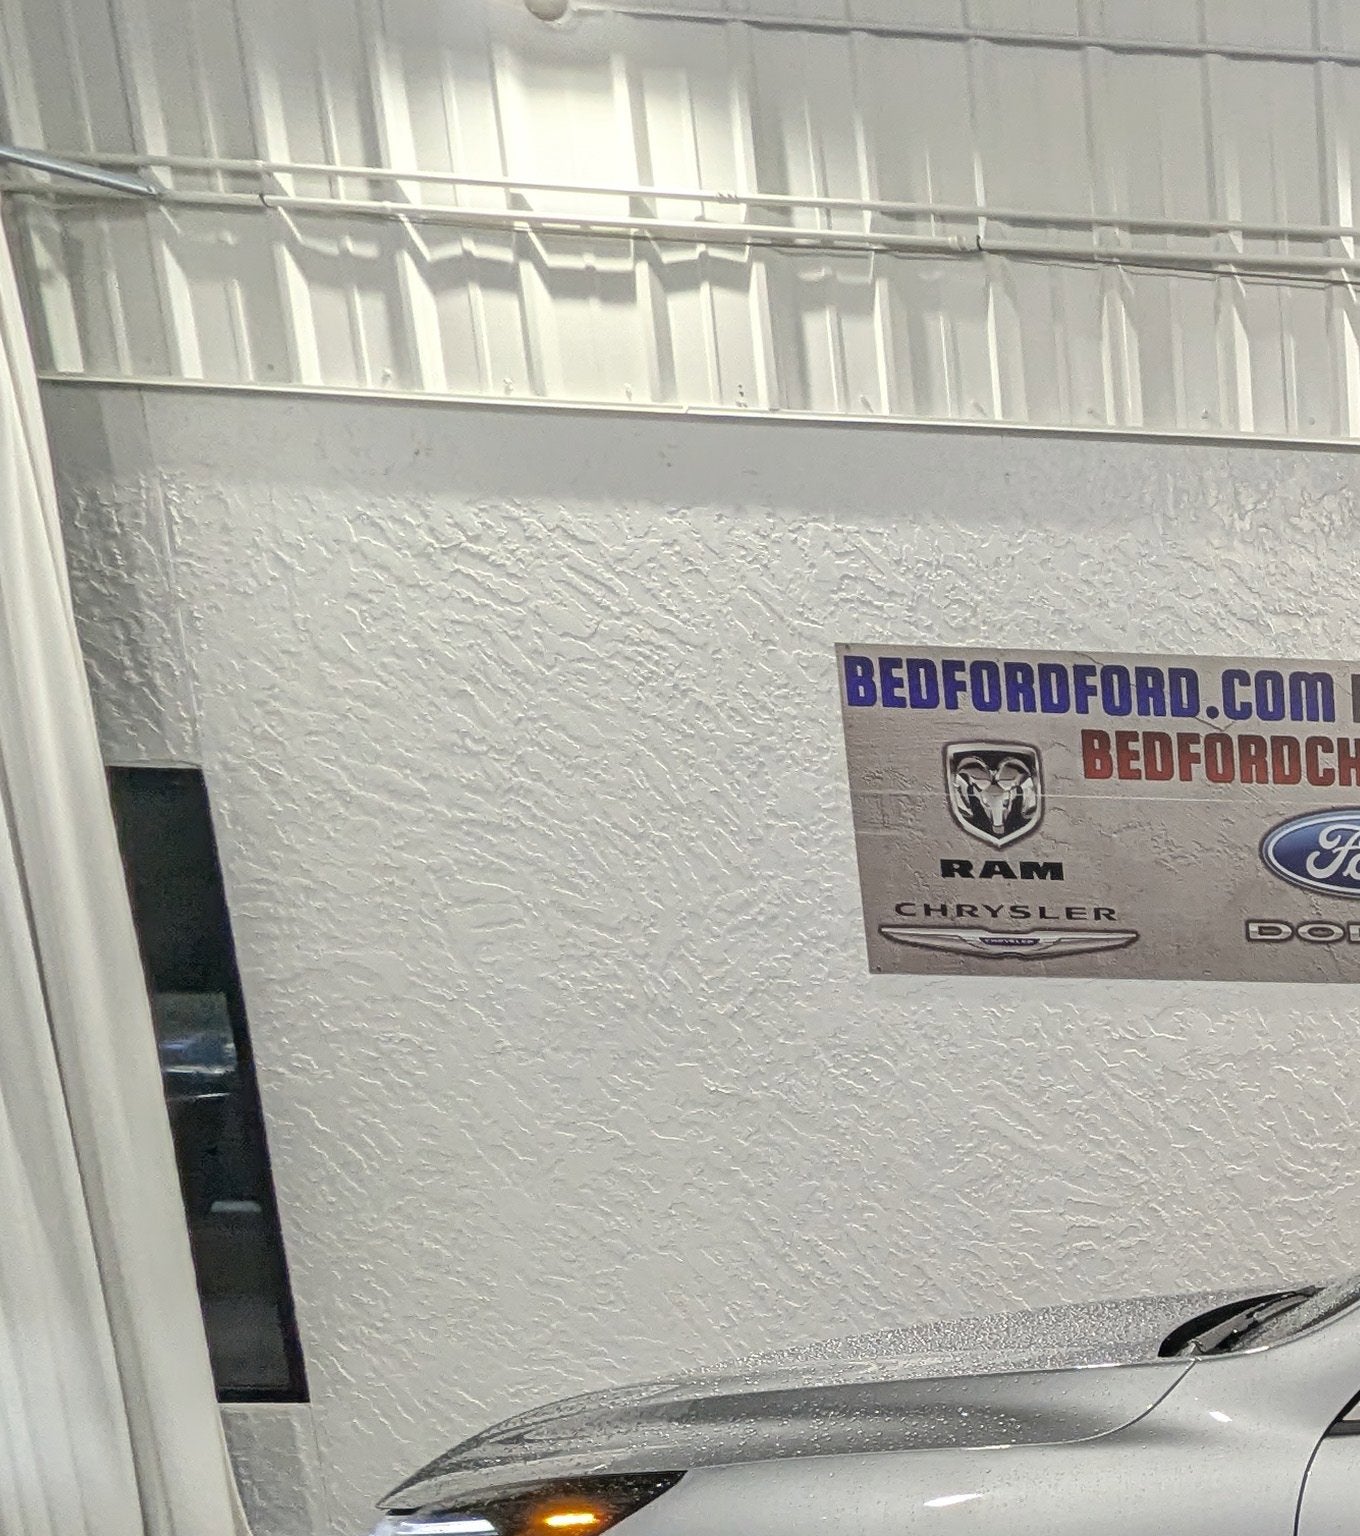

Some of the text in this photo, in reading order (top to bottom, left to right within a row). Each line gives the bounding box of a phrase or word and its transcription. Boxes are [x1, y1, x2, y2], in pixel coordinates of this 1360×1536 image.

[843, 654, 1337, 723] BEDFORDFORD.COM
[939, 858, 1065, 881] RAM
[894, 902, 1118, 922] CHRYSLER
